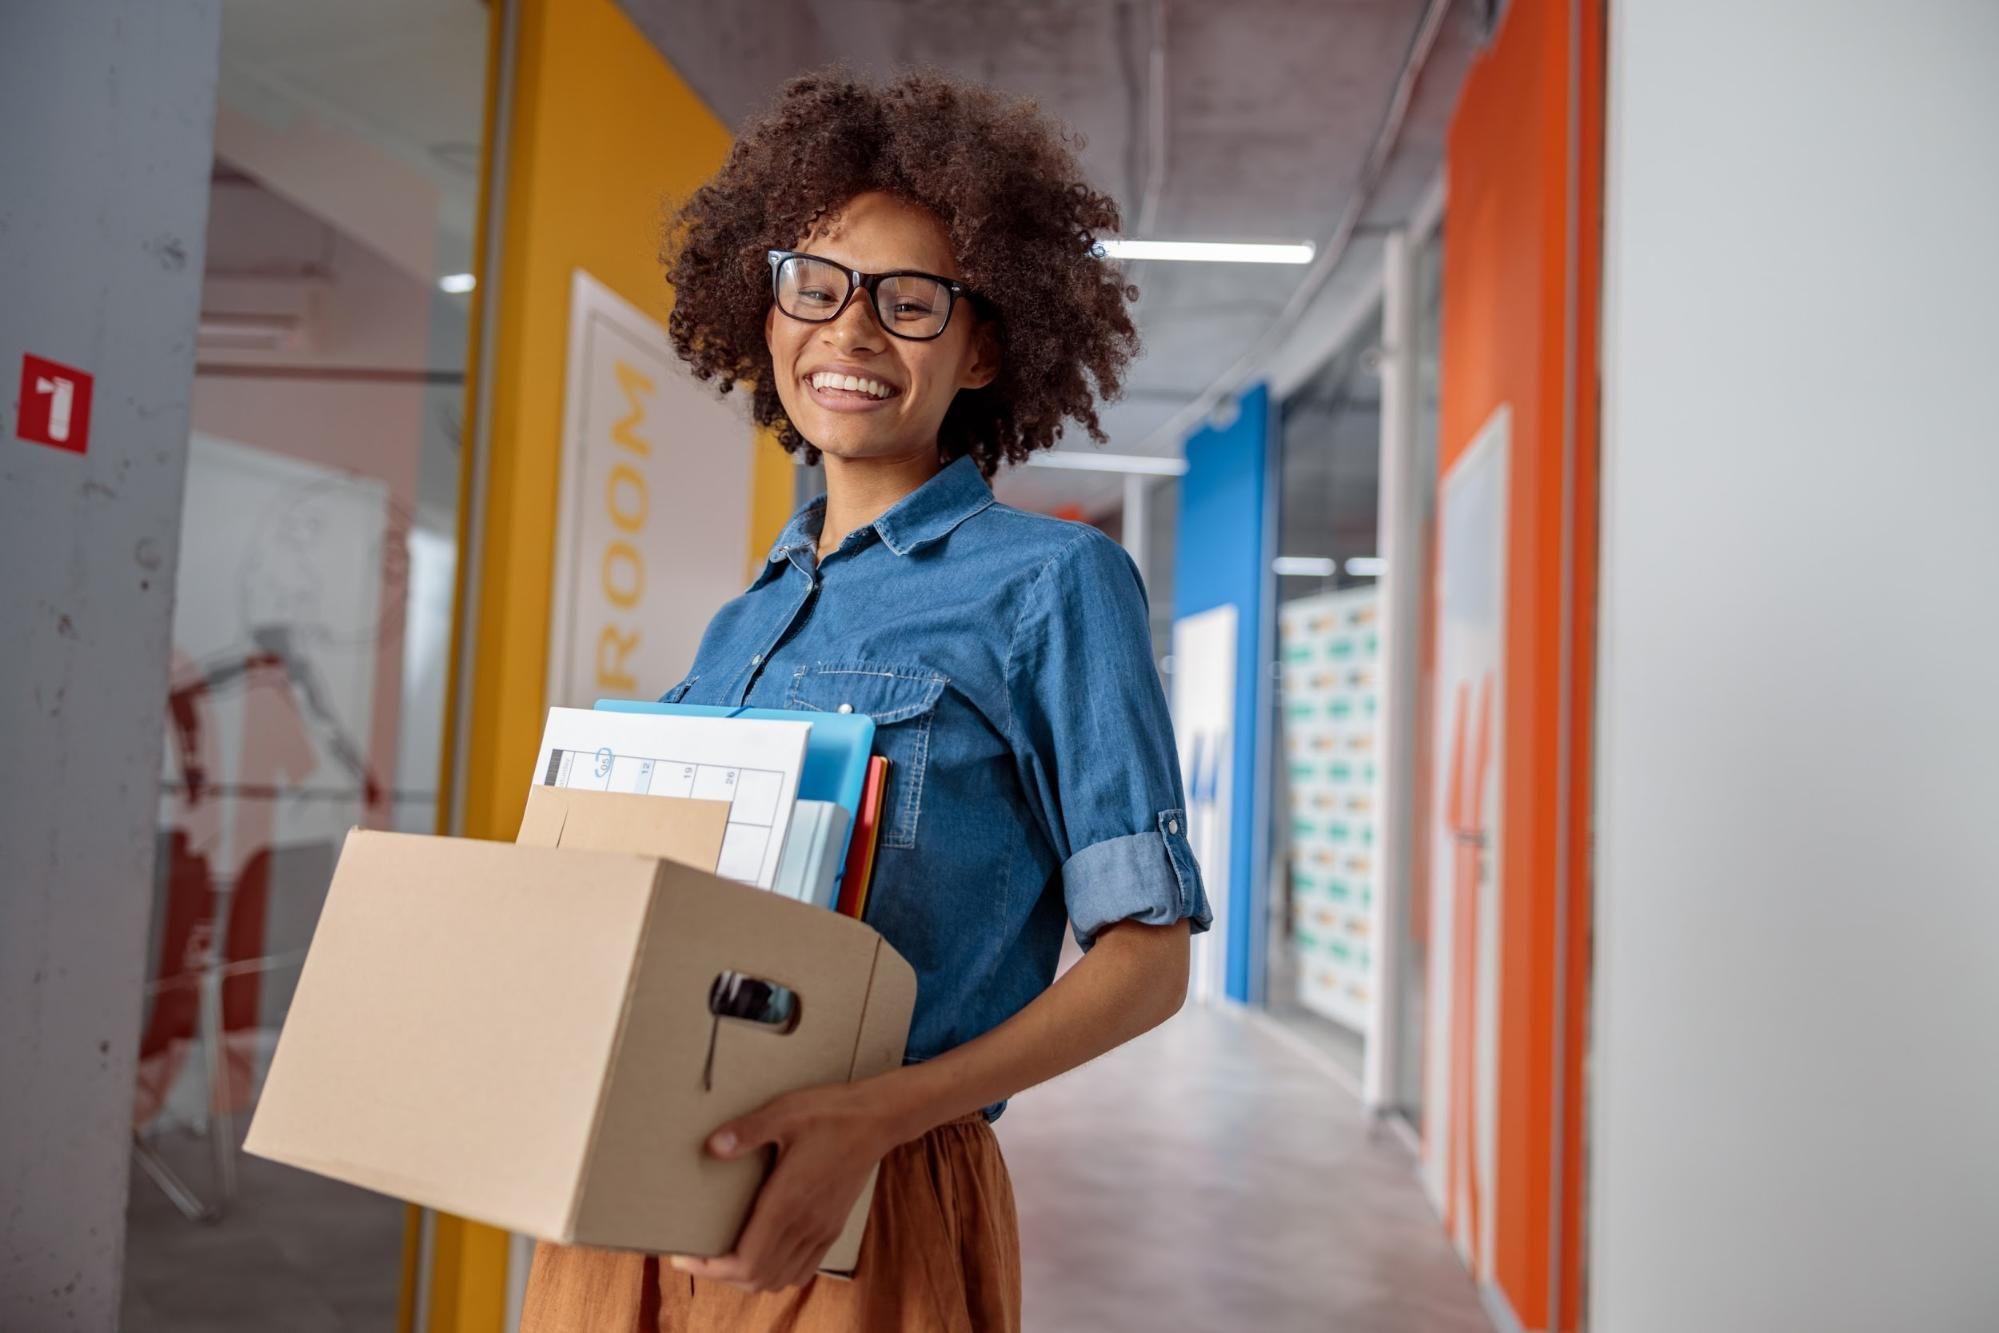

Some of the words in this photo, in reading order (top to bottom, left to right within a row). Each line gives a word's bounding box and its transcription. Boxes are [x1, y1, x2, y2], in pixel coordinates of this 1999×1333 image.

[597, 360, 657, 694] ROOM
[600, 758, 610, 771] 05
[641, 762, 650, 774] 12
[683, 767, 692, 778] 19
[725, 771, 736, 785] 26
